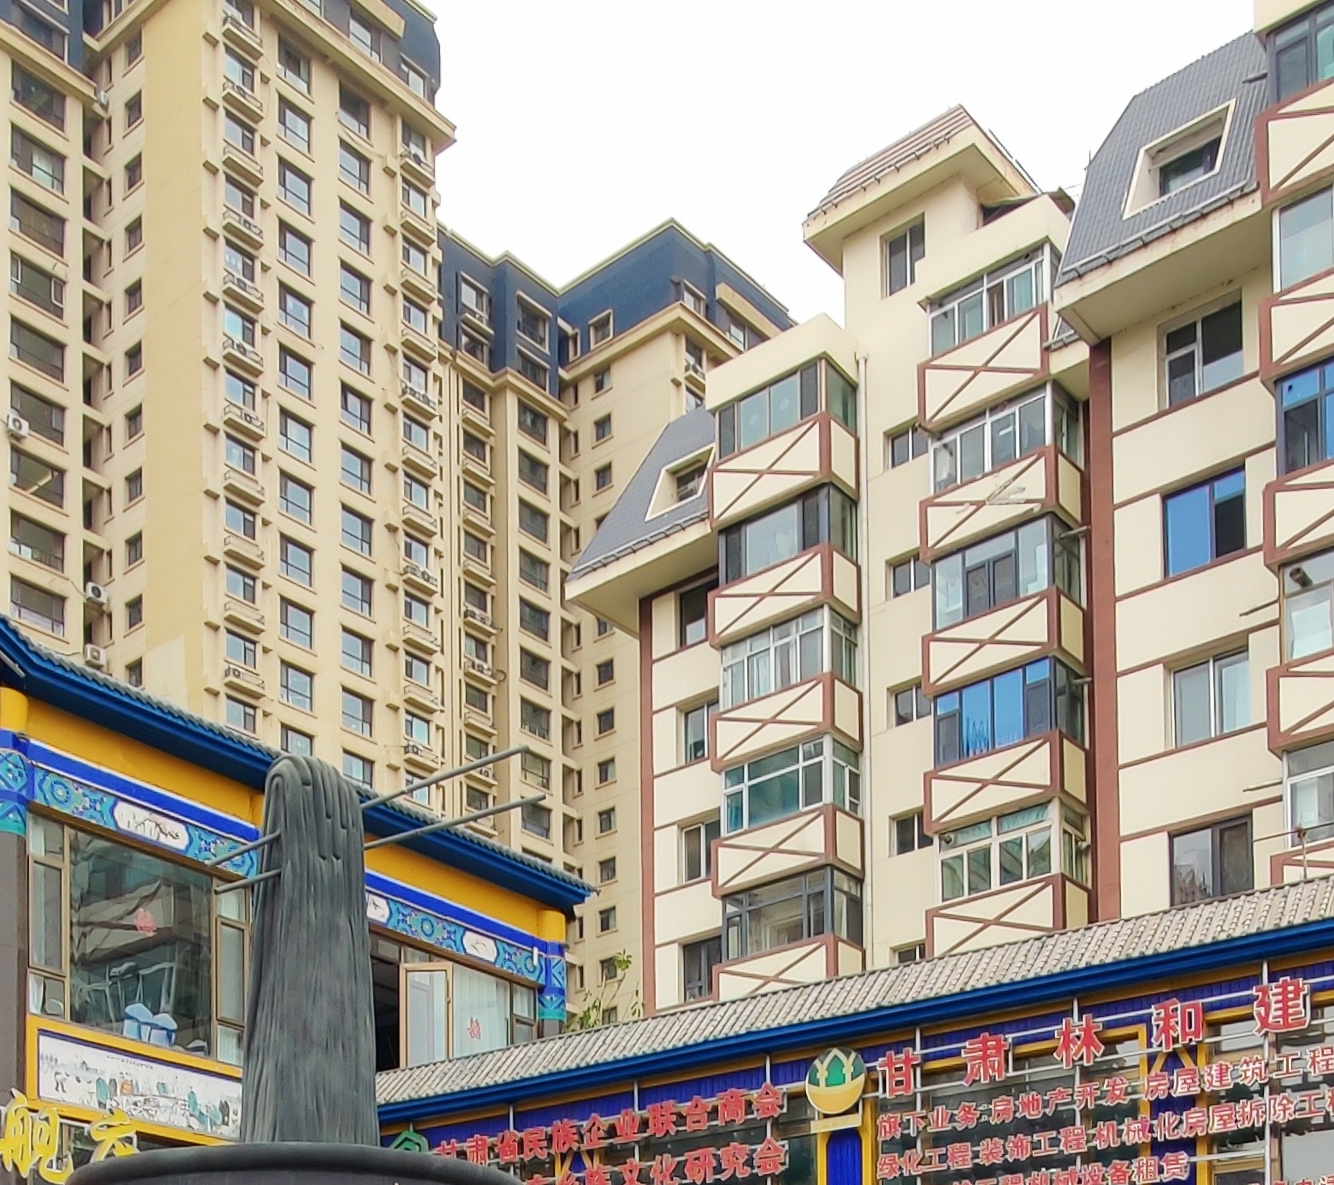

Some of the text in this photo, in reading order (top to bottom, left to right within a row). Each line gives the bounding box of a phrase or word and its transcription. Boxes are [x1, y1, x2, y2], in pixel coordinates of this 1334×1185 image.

[435, 1081, 788, 1166] 甘肃省民族企业联合商会
[876, 1143, 973, 1180] 绿化工程
[979, 1122, 1087, 1165] 装饰工程
